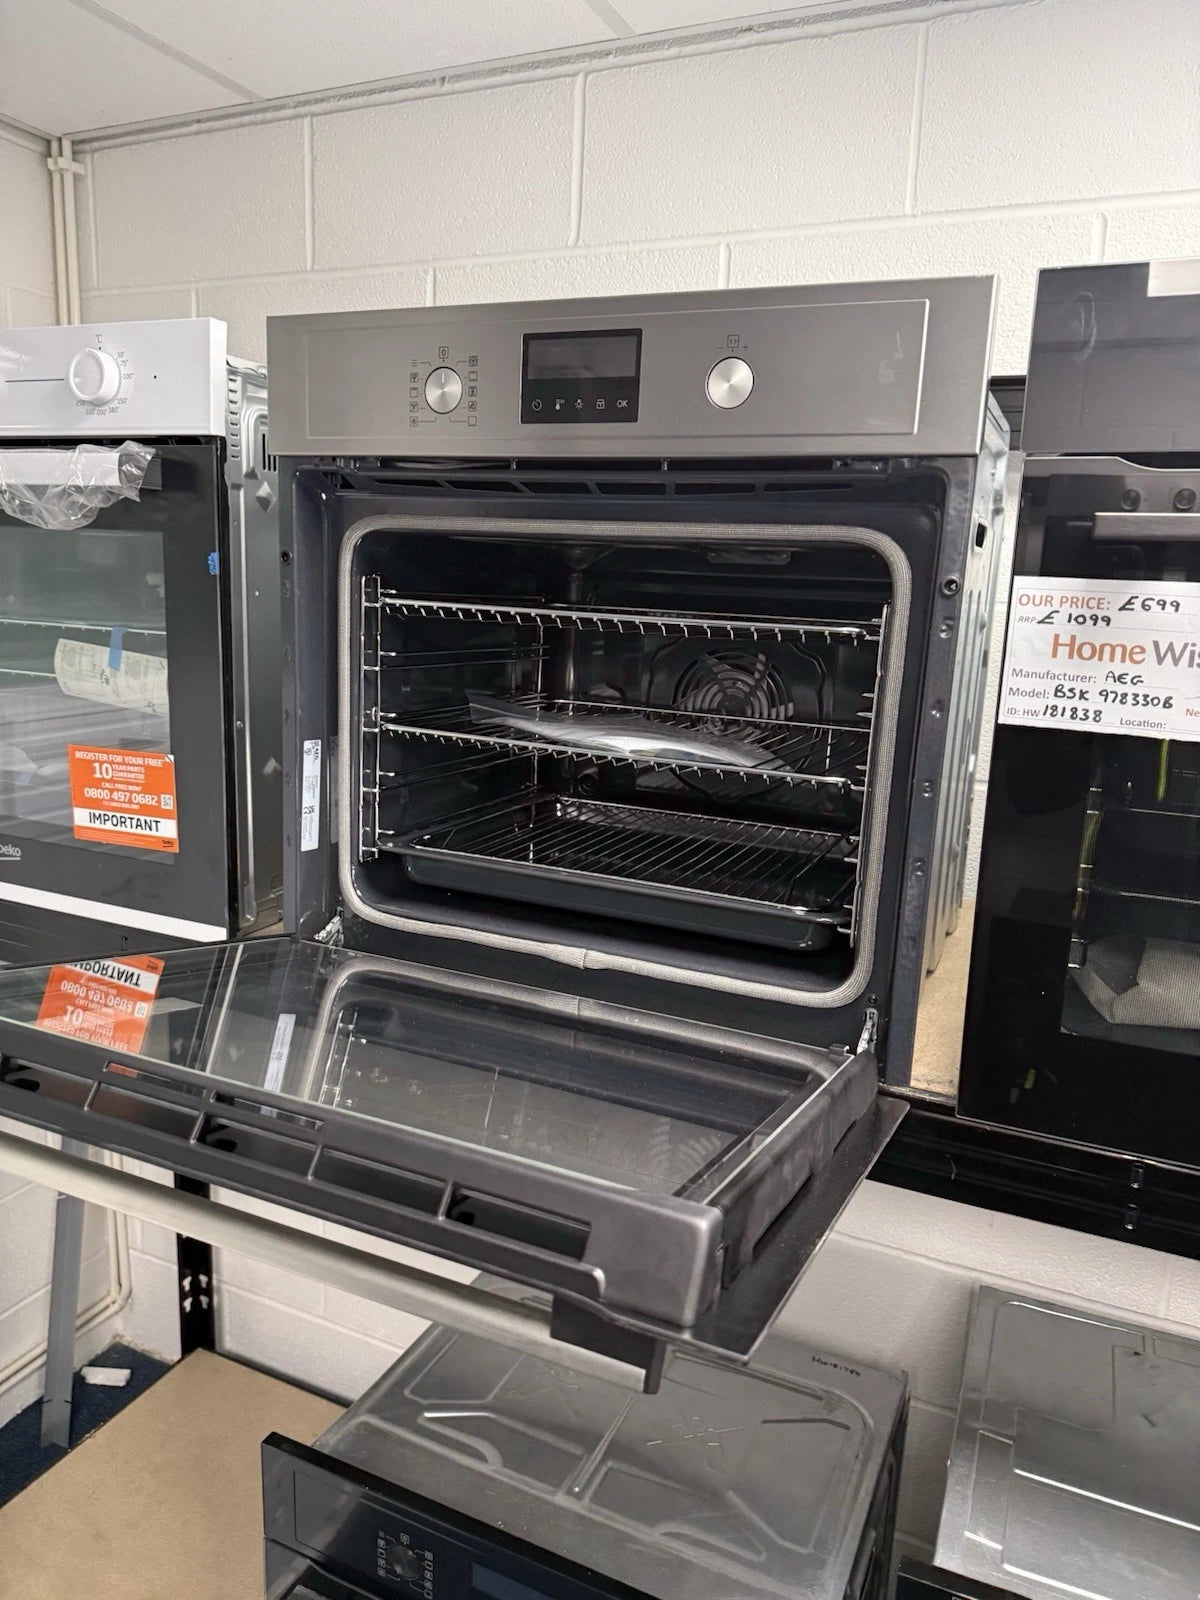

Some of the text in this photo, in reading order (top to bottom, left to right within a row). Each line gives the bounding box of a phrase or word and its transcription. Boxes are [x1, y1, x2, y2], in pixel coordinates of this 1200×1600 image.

[616, 399, 629, 408] OK
[1018, 593, 1054, 608] OUR
[1059, 595, 1111, 611] PRICE:
[1067, 612, 1112, 627] 1099
[1011, 667, 1145, 685] Manufacturer: AEG
[1008, 684, 1174, 709] Model: BSK 978330B
[1006, 704, 1103, 723] ID: HW 181838
[1119, 717, 1167, 730] Location:
[75, 750, 109, 761] REGISTER
[109, 754, 123, 762] FOR
[124, 755, 144, 764] YOUR
[92, 761, 113, 780] 10
[84, 787, 110, 800] 0800
[111, 790, 130, 803] 497
[131, 793, 159, 806] 0682
[88, 811, 161, 833] IMPORTANT
